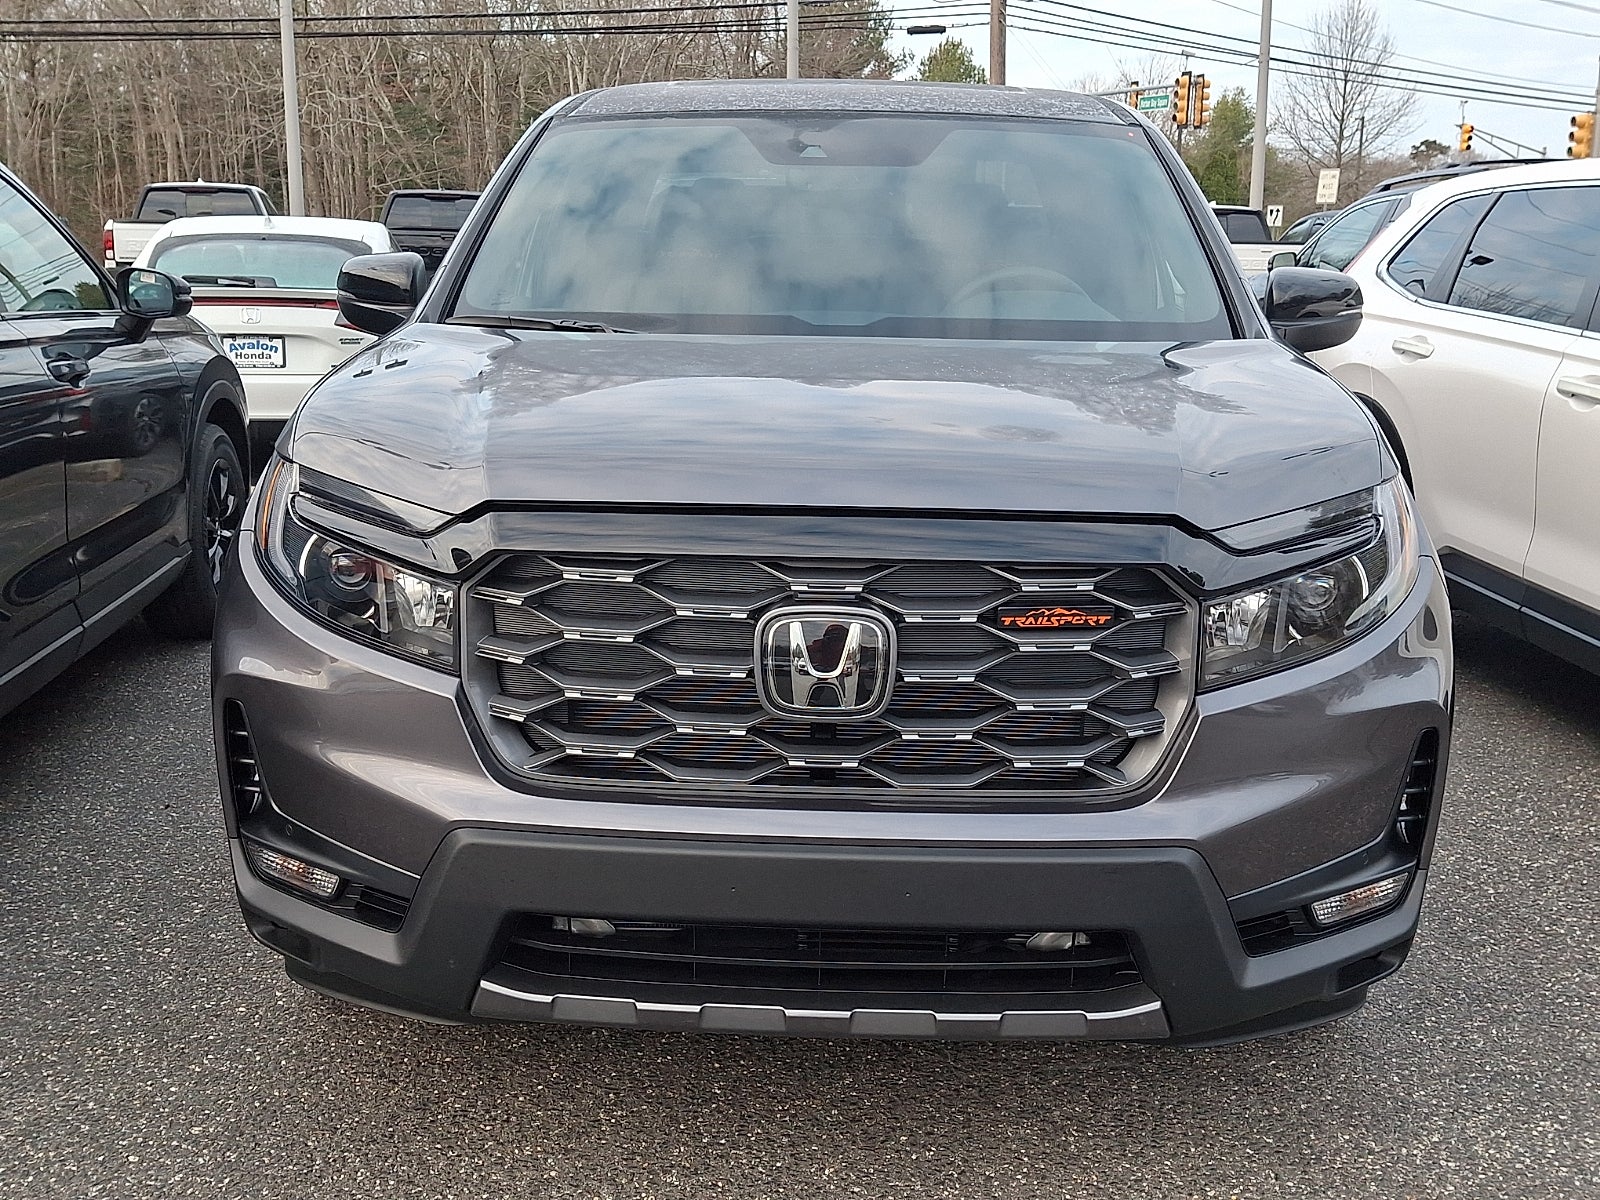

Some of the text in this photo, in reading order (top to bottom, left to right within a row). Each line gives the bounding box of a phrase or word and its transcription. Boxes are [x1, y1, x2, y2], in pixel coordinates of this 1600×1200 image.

[229, 340, 279, 353] Avalon
[235, 351, 272, 360] Honda
[1001, 616, 1111, 627] TRAILSPORT
